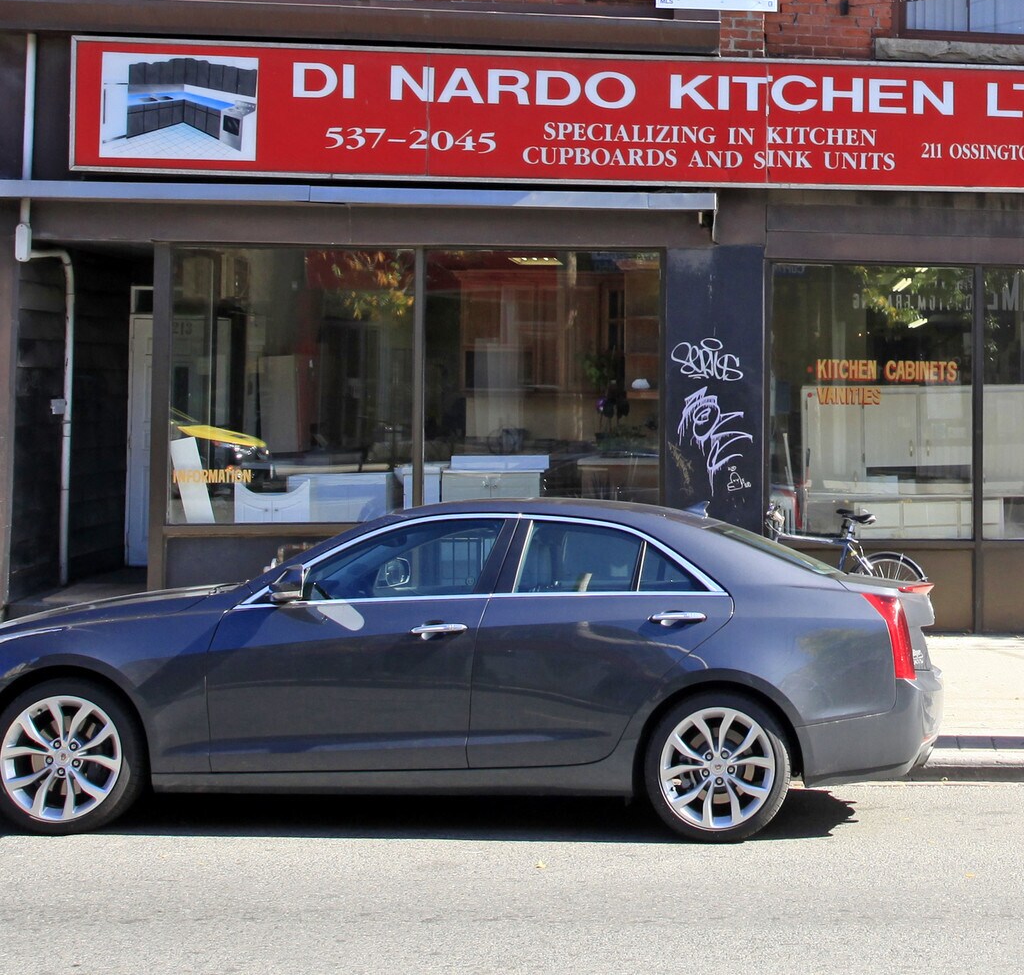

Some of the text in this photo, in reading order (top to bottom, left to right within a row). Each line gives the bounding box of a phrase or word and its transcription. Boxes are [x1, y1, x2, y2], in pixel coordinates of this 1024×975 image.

[293, 62, 355, 99] DI
[390, 66, 637, 109] NARDO
[669, 74, 955, 116] KITCHEN
[324, 127, 497, 154] 537-2045
[543, 122, 877, 147] SPECIALIZING IN KITCHEN
[522, 146, 896, 172] CUPBOARDS AND SINK UNITS
[921, 142, 943, 159] 211
[816, 359, 959, 383] KITCHEN CABINETS
[816, 387, 882, 405] VANITIES
[173, 469, 252, 483] INFORMATION
